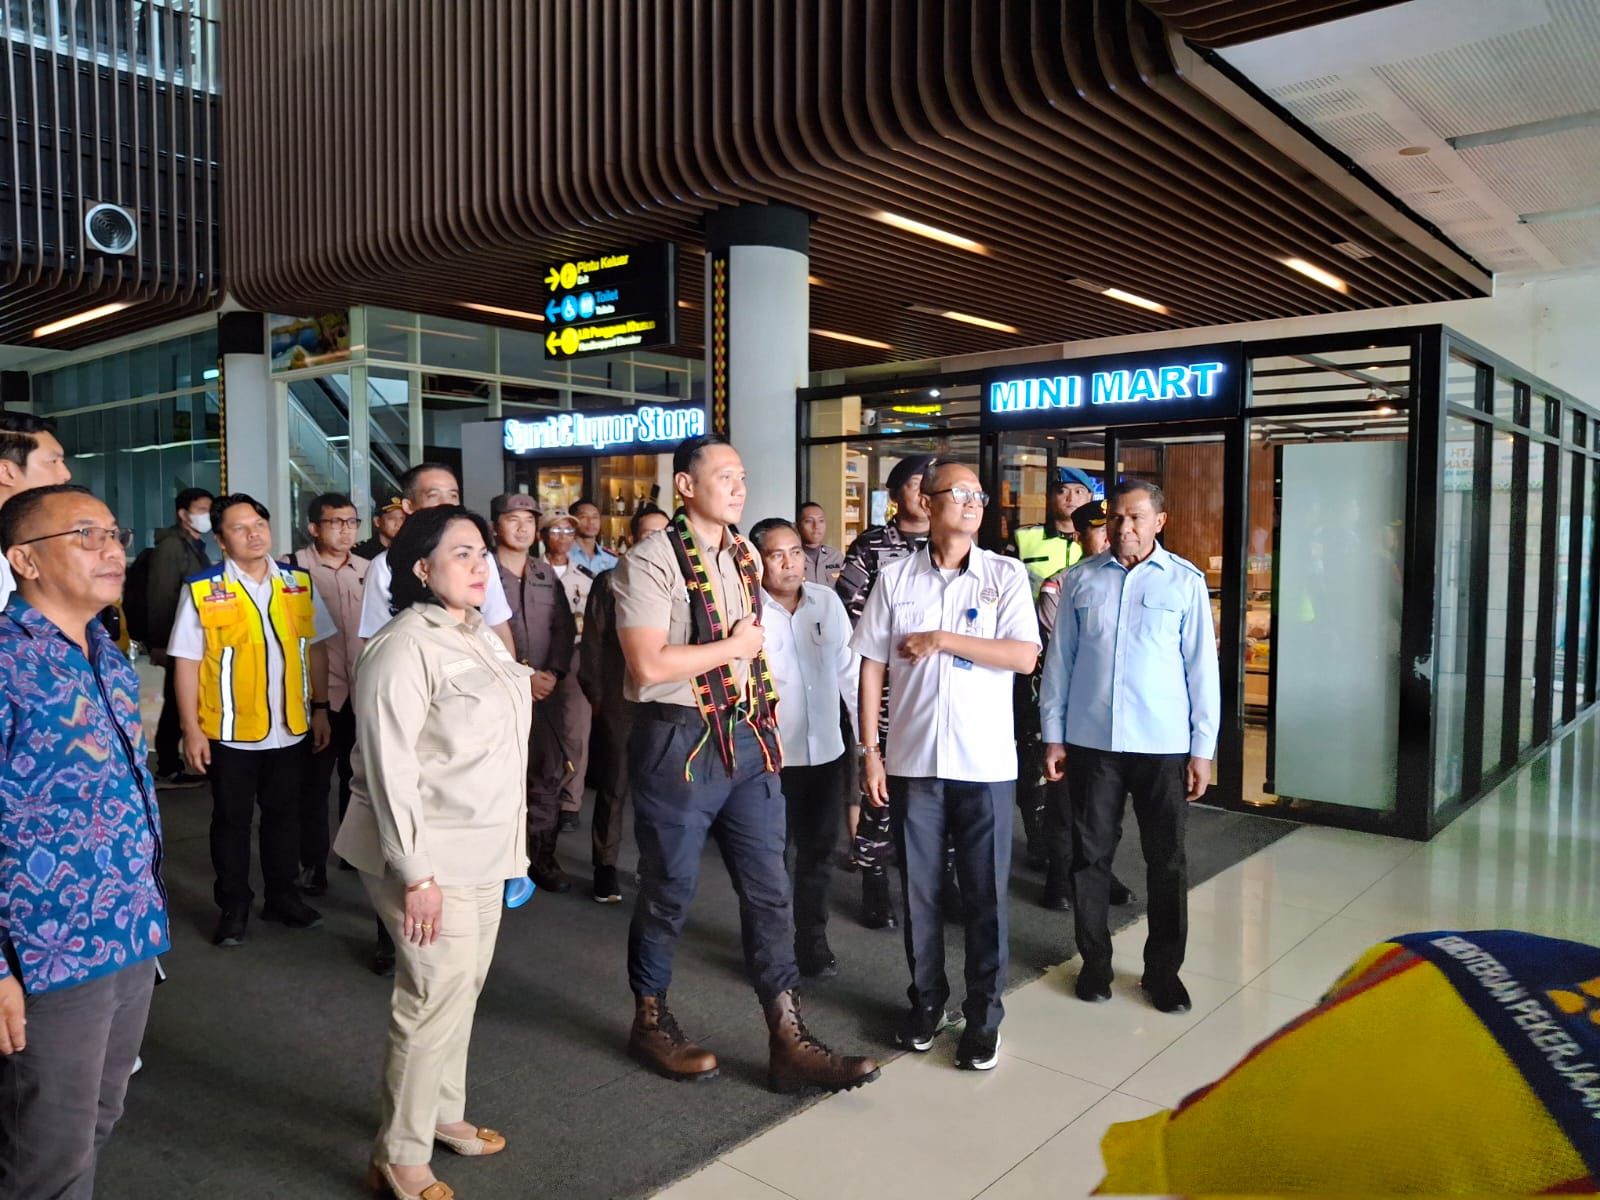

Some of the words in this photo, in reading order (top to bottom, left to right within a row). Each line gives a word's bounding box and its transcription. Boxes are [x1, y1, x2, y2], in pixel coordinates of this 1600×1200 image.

[577, 260, 600, 274] Pintu
[600, 255, 630, 269] Keluar
[595, 289, 619, 302] Toilet
[991, 375, 1082, 413] MINI
[1091, 362, 1223, 405] MART
[637, 406, 705, 442] Store
[1504, 1000, 1600, 1119] PEKERJAA
